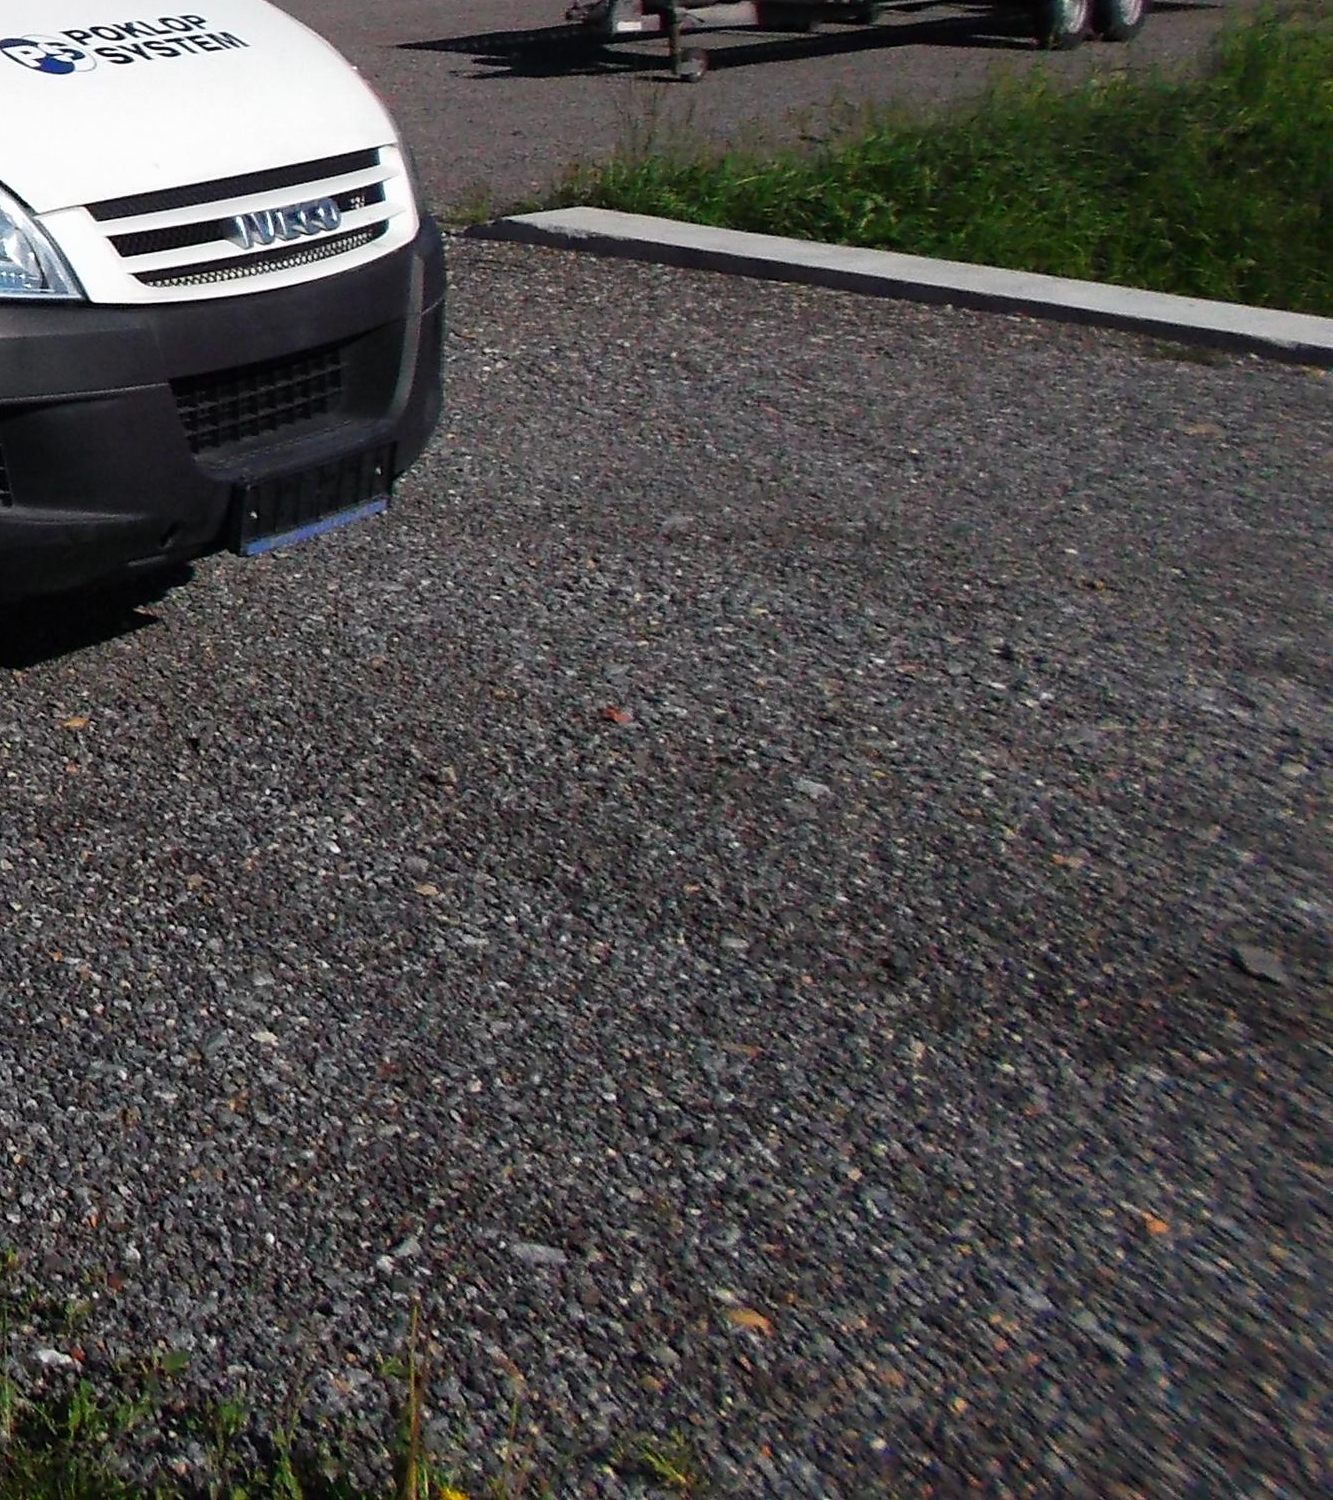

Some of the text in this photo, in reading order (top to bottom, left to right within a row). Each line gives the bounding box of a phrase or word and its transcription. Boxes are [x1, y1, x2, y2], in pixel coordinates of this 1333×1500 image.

[59, 14, 208, 46] POKLOP
[93, 31, 251, 65] SYSTEM
[232, 197, 342, 250] IVECO
